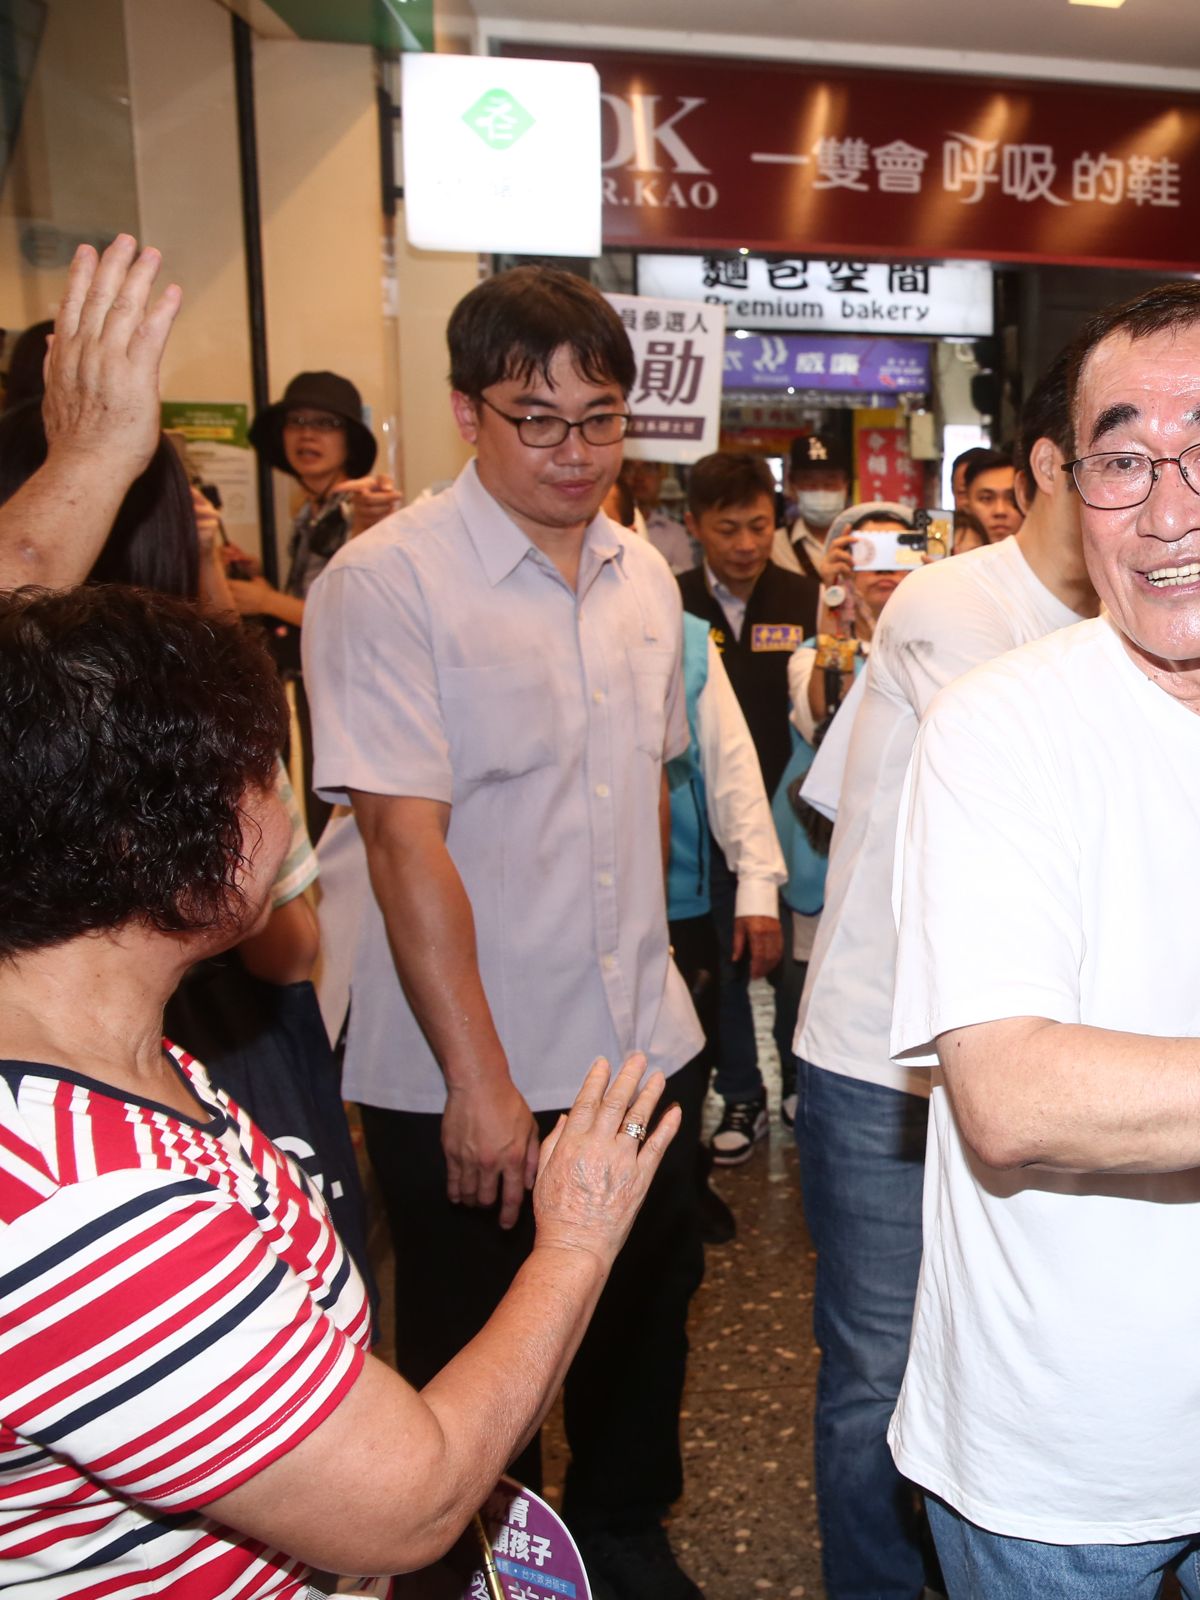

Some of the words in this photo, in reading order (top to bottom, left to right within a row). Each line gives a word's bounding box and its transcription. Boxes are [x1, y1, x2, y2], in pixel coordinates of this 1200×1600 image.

[750, 131, 1181, 209] 一雙會呼吸的鞋
[841, 296, 930, 322] bakery
[635, 339, 704, 406] 勛
